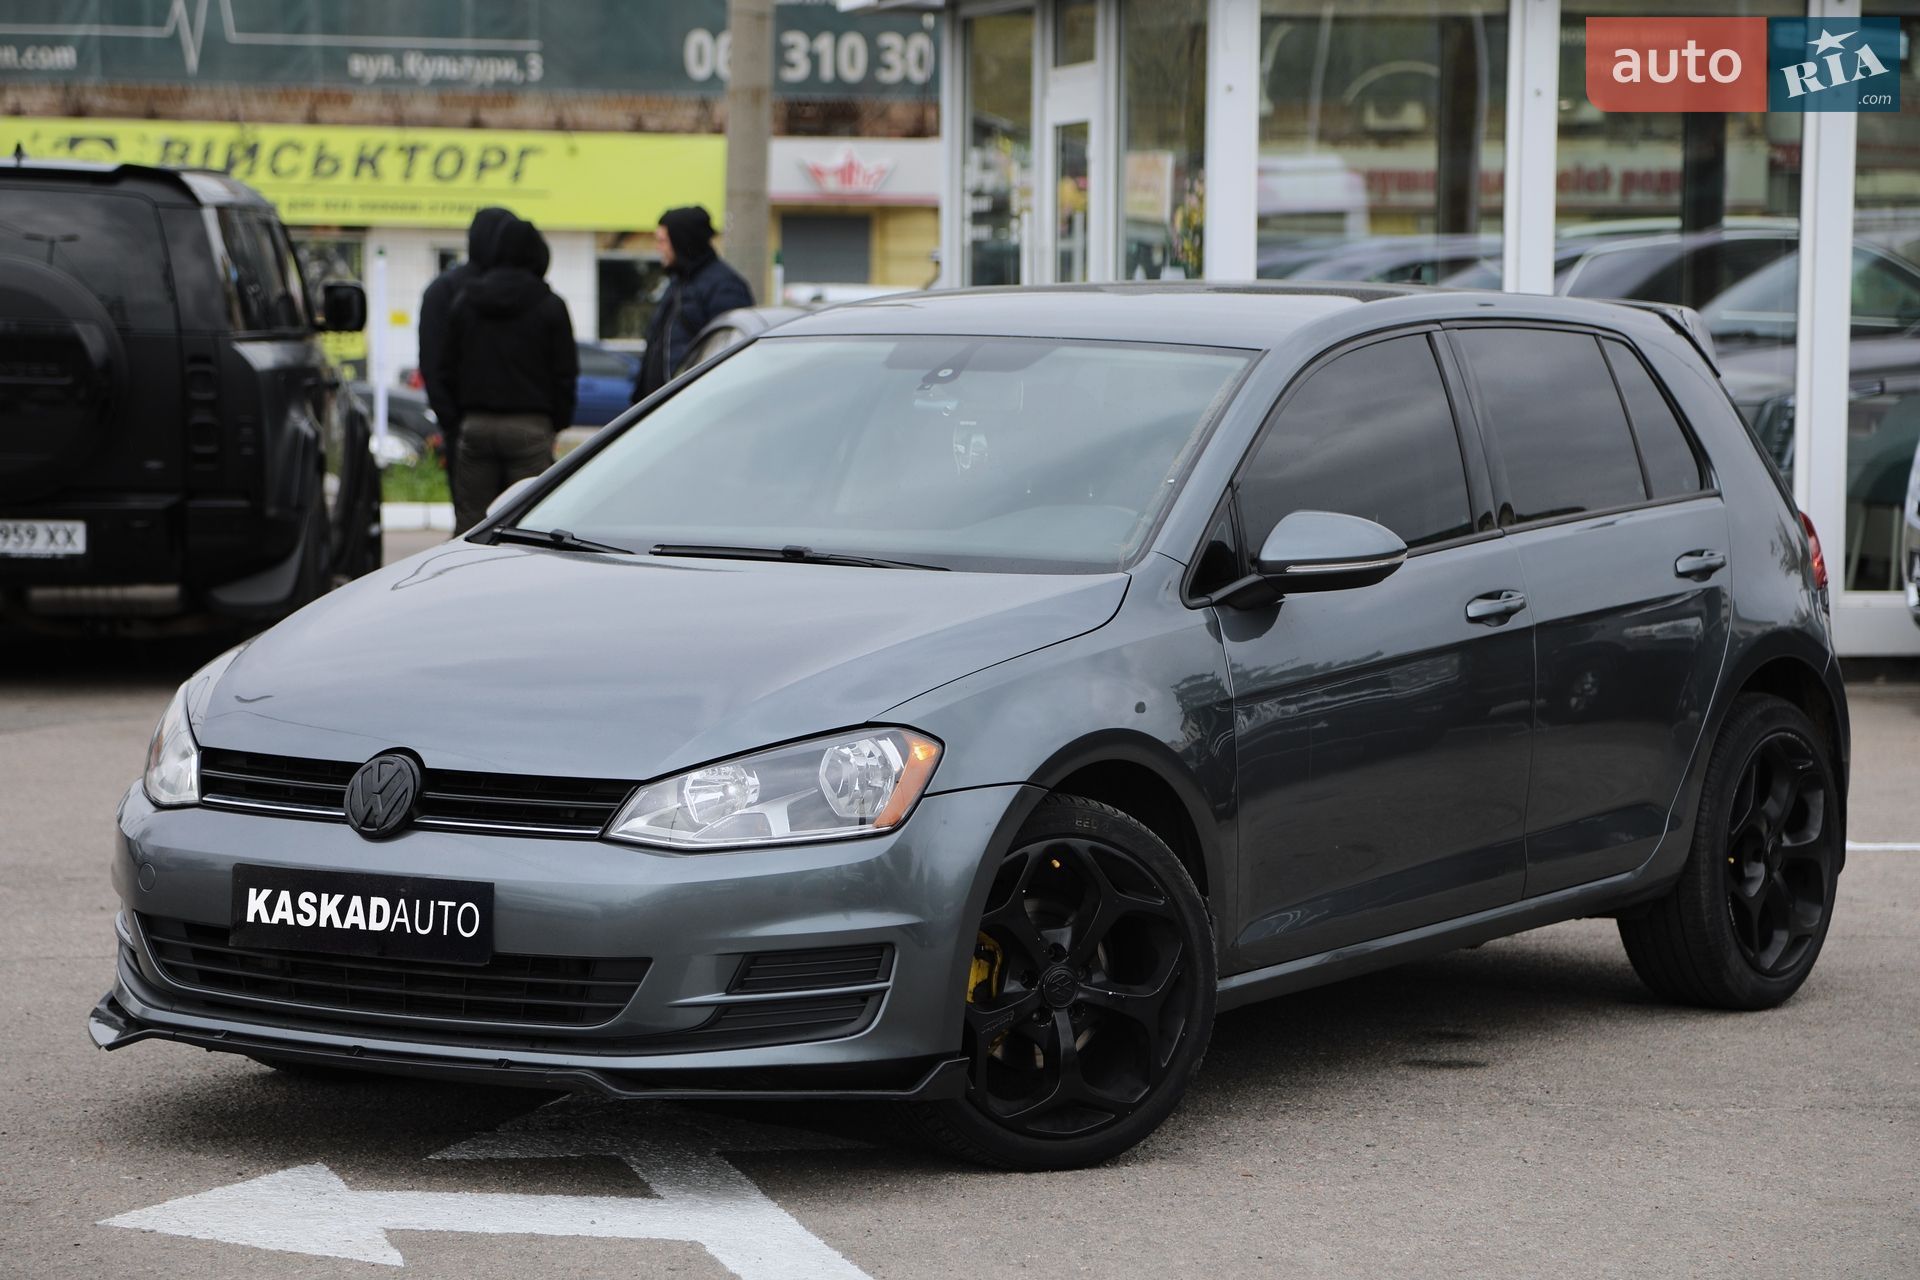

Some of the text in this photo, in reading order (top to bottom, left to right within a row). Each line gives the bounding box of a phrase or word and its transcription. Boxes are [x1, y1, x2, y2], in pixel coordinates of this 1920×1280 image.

[779, 29, 869, 84] 310
[874, 31, 935, 85] 30
[246, 887, 480, 938] KASKADAUTO
